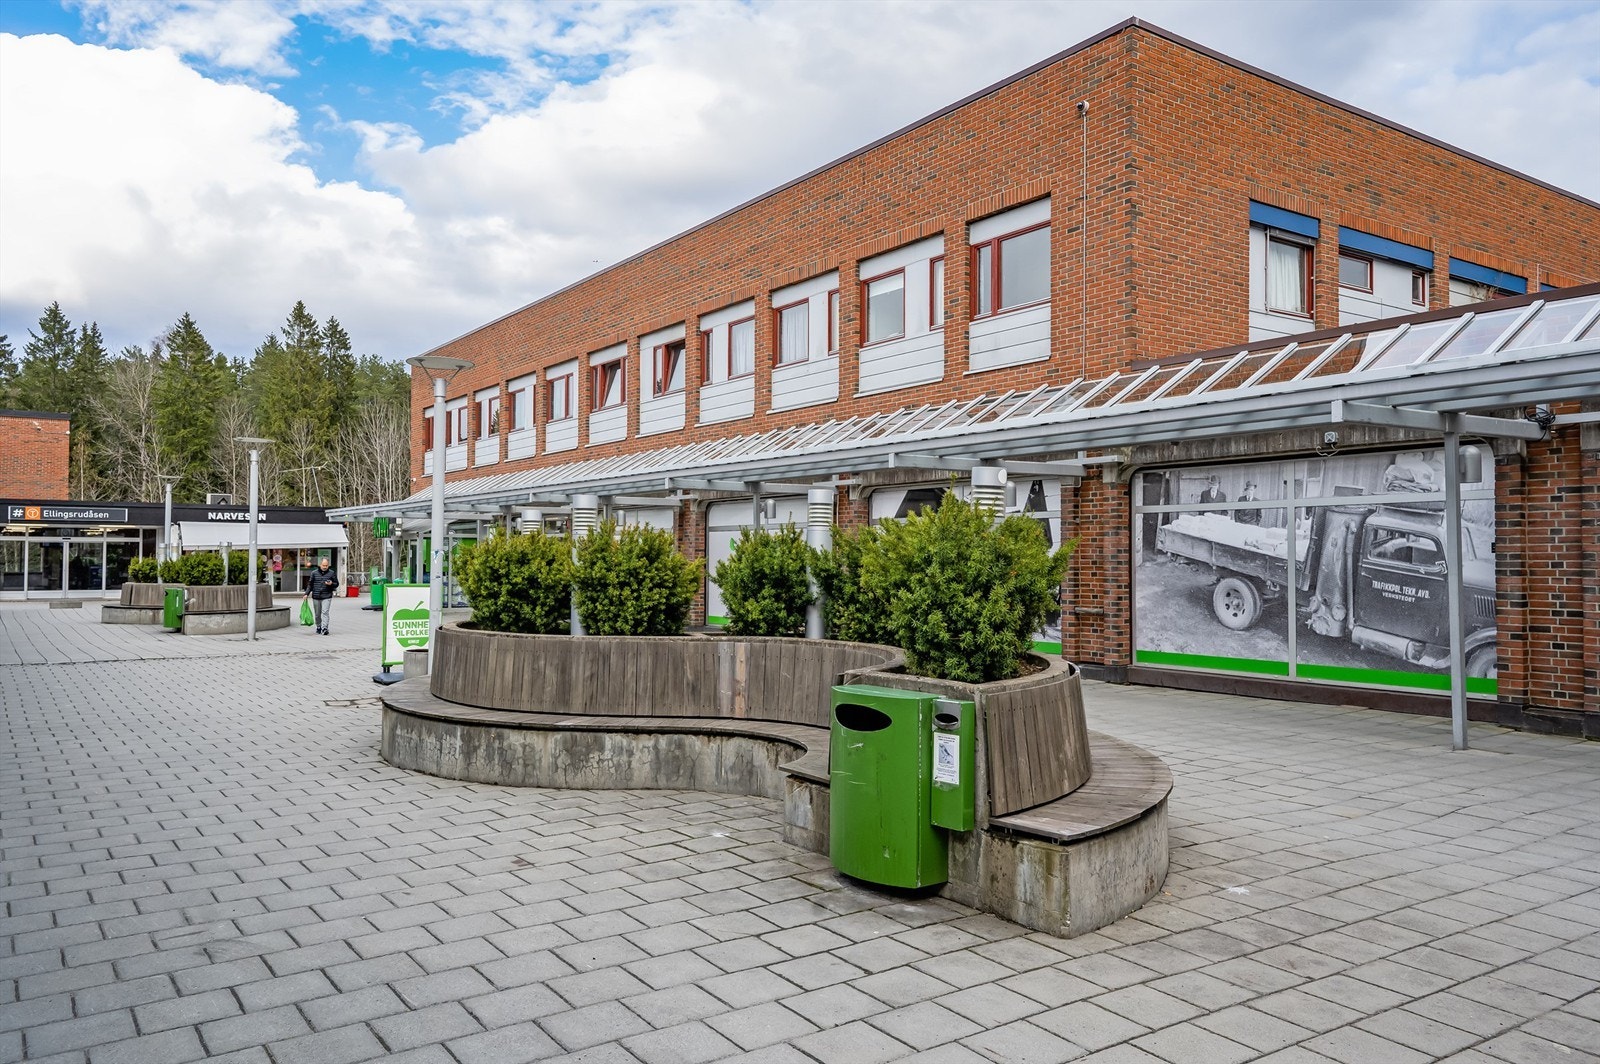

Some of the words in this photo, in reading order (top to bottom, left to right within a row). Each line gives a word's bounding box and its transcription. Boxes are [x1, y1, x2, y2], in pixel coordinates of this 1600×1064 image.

[43, 509, 109, 520] Ellingsrudåsen
[207, 511, 267, 521] NARVESN
[392, 621, 429, 629] SUNNHE
